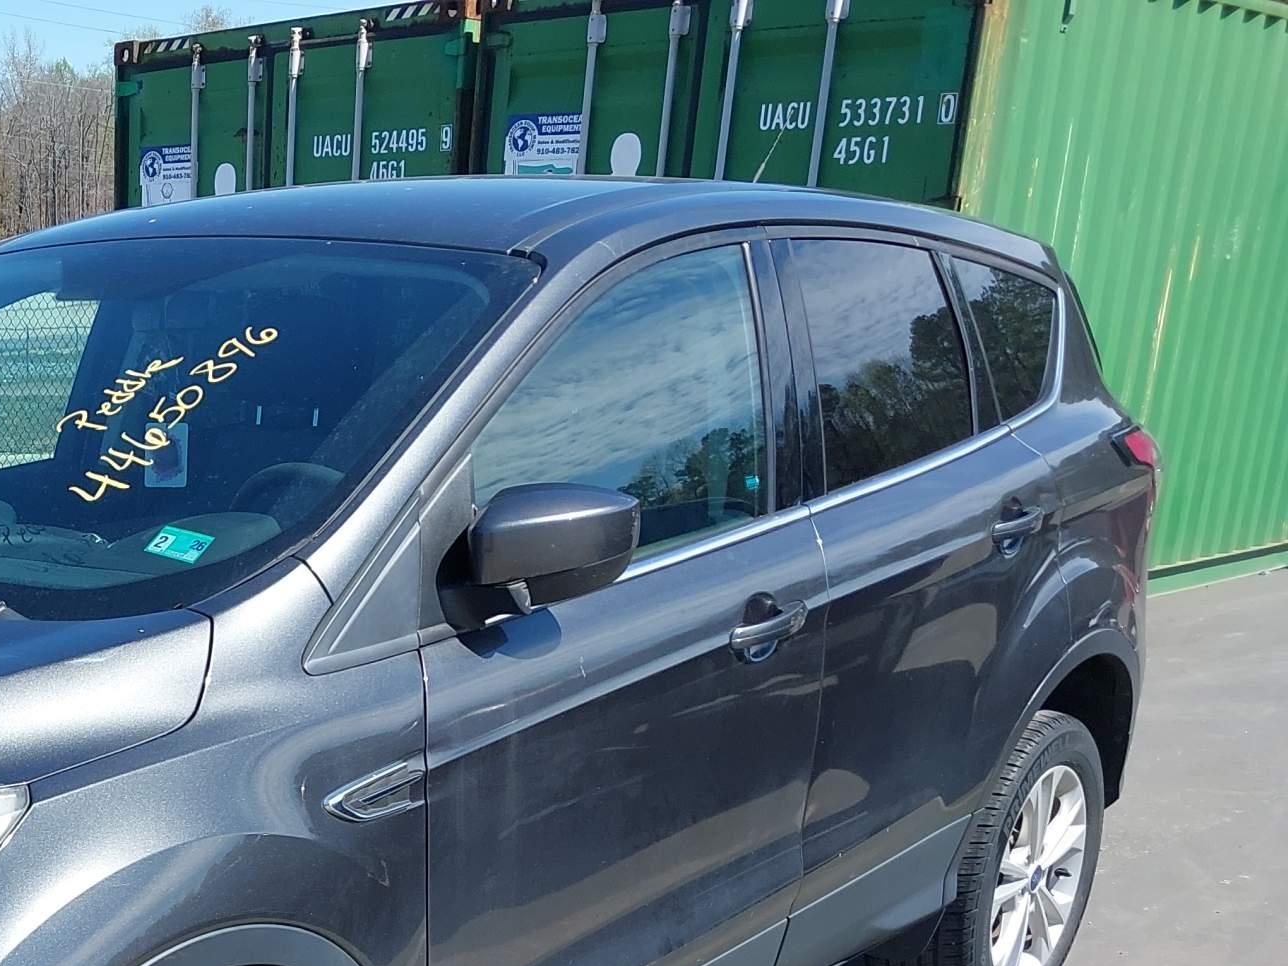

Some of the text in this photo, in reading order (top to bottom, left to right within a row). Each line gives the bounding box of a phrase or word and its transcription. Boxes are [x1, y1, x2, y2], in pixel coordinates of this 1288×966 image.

[759, 94, 955, 130] UACU 533731 0
[313, 126, 451, 157] UACU 524495 9
[832, 136, 890, 165] 45G1
[68, 326, 278, 501] 44650896
[153, 535, 169, 548] 2
